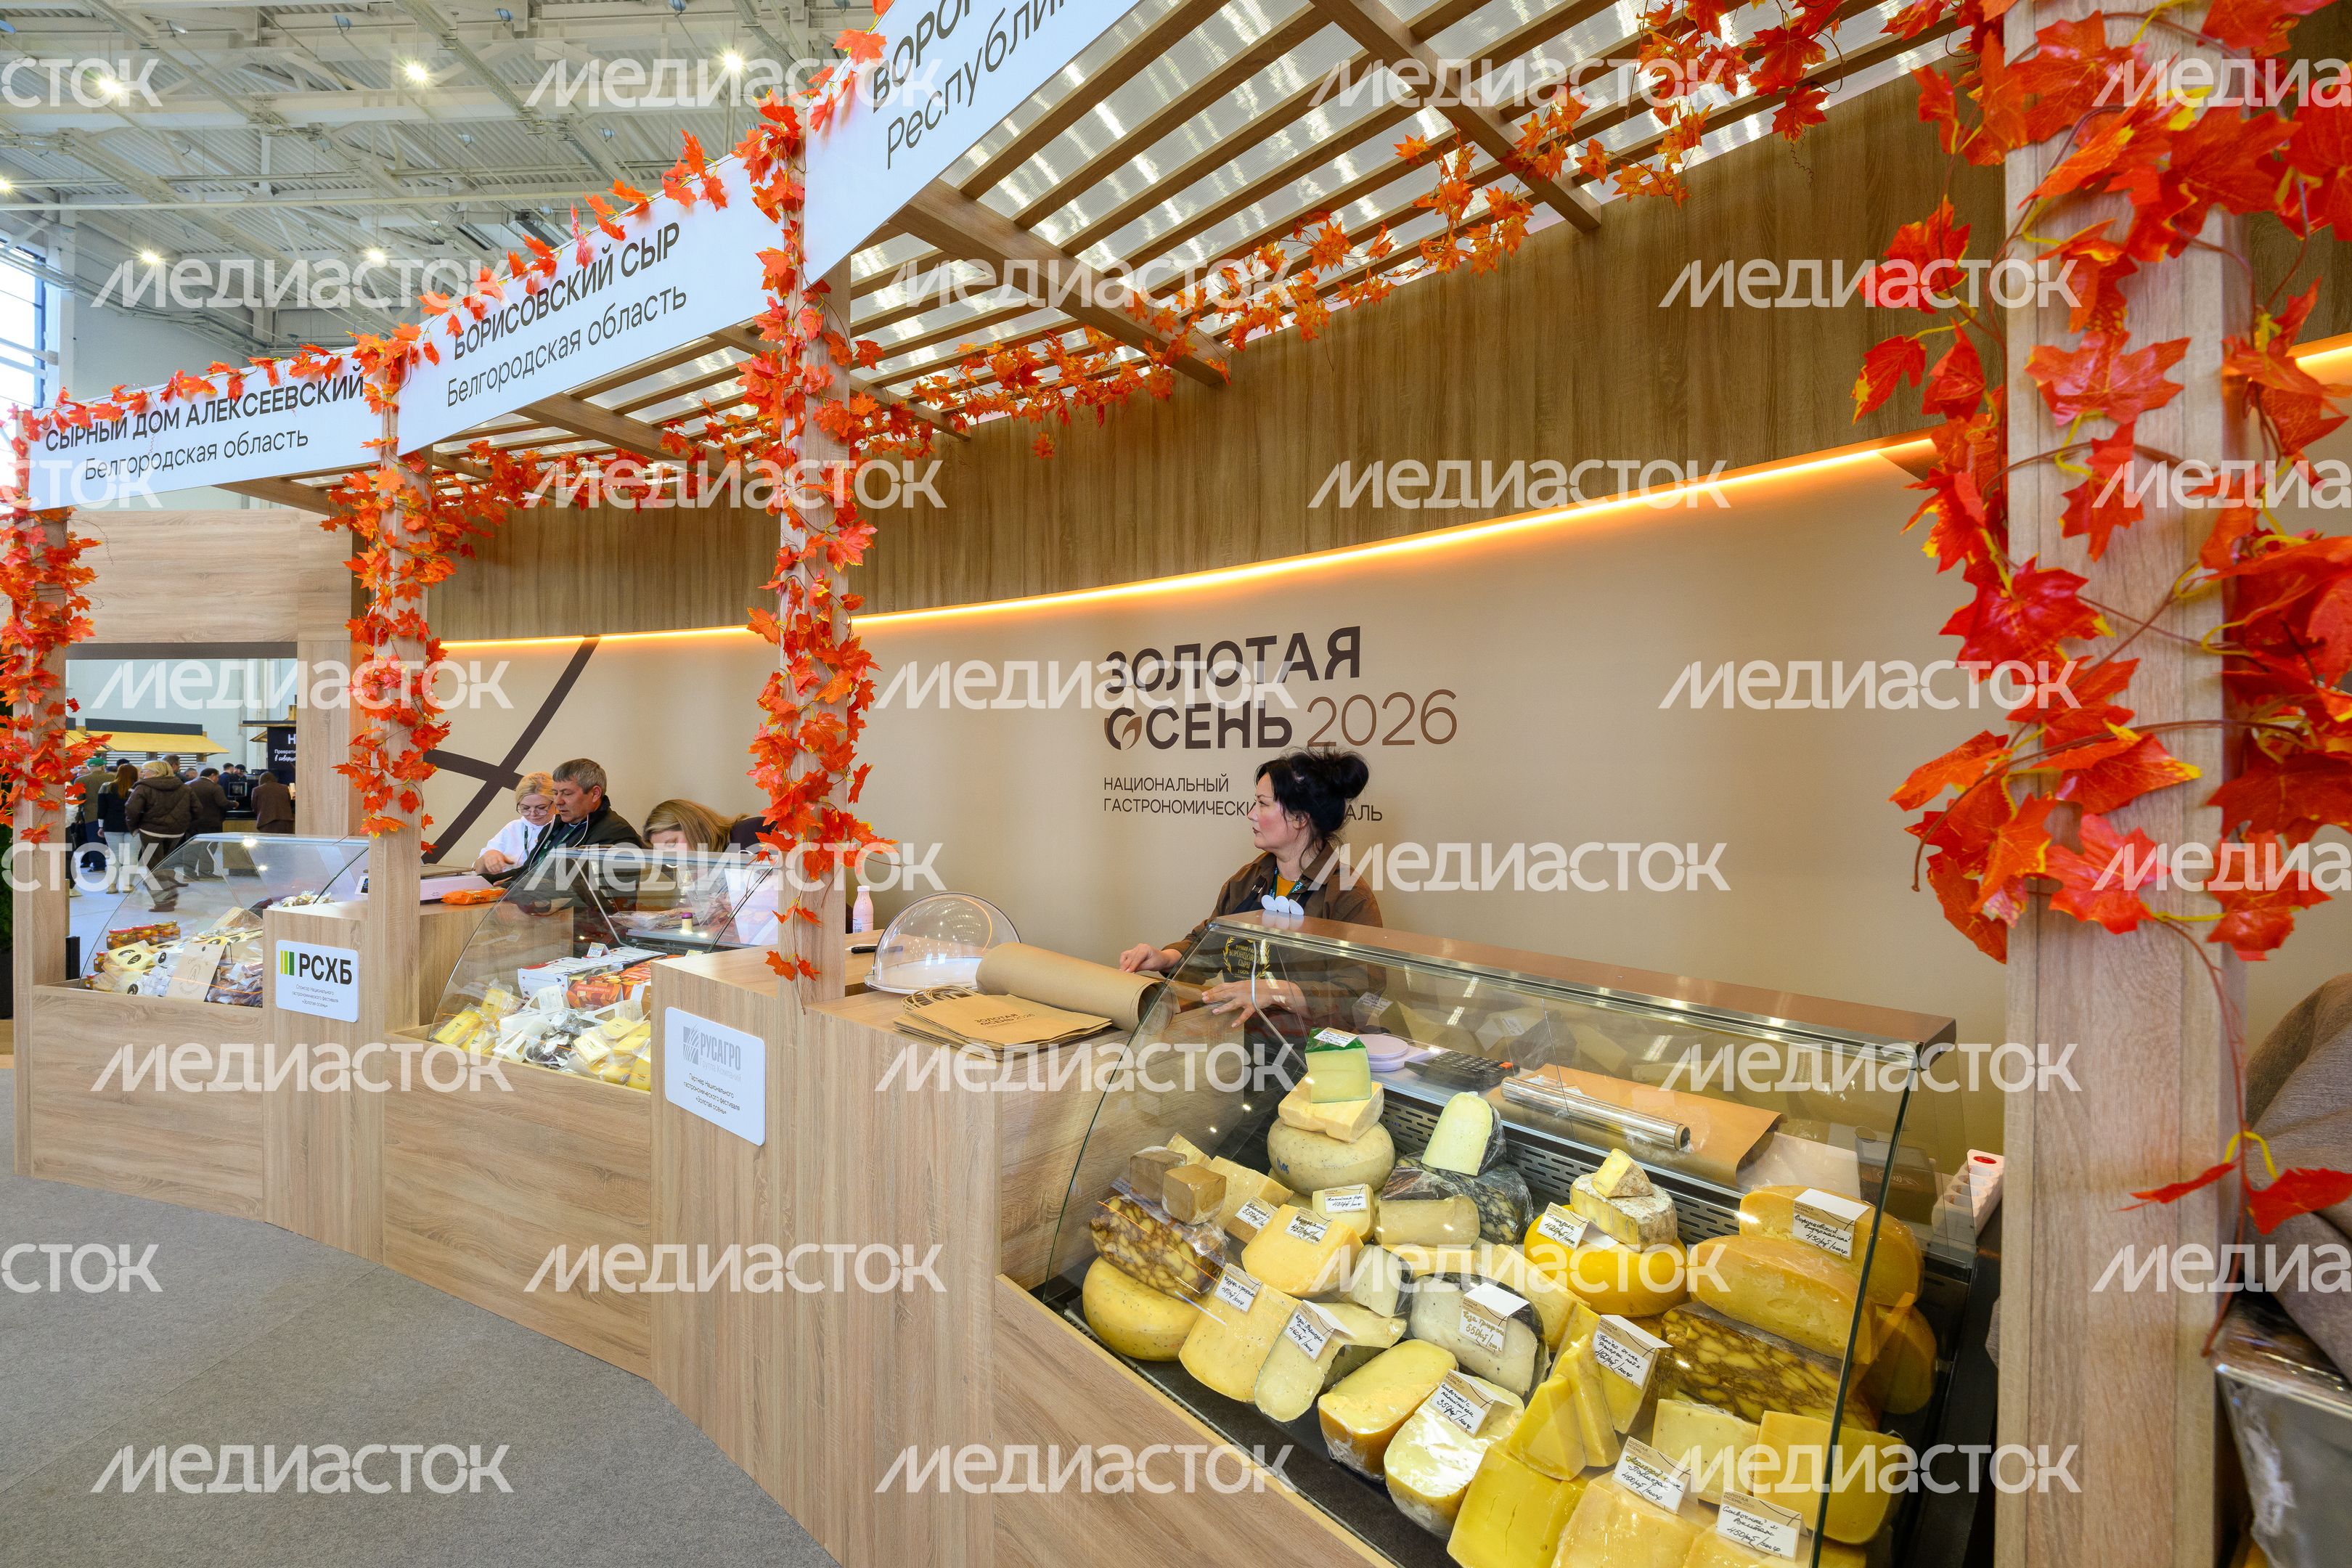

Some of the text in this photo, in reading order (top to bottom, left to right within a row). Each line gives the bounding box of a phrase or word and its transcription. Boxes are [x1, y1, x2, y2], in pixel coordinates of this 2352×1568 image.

[873, 0, 970, 114] ВОРО
[887, 0, 1064, 170] Республи
[454, 222, 680, 361] БОРИСОВСКИЙ СЫР
[447, 286, 687, 407] Белгородская область
[46, 365, 364, 452] СЫРНЫЙ ДОМ АЛЕКСЕЕВСКИЙ
[85, 428, 309, 481] Белгородская область
[1104, 625, 1362, 695] ЗОЛОТАЯ
[1103, 688, 1458, 751] ОСЕНЬ 2026
[1103, 773, 1230, 796] НАЦИОНАЛЬНЫЙ
[1103, 797, 1256, 817] ГАСТРОНОМИЧЕСКИ
[299, 952, 352, 985] РСХБ
[701, 1032, 741, 1071] РУСАГРО
